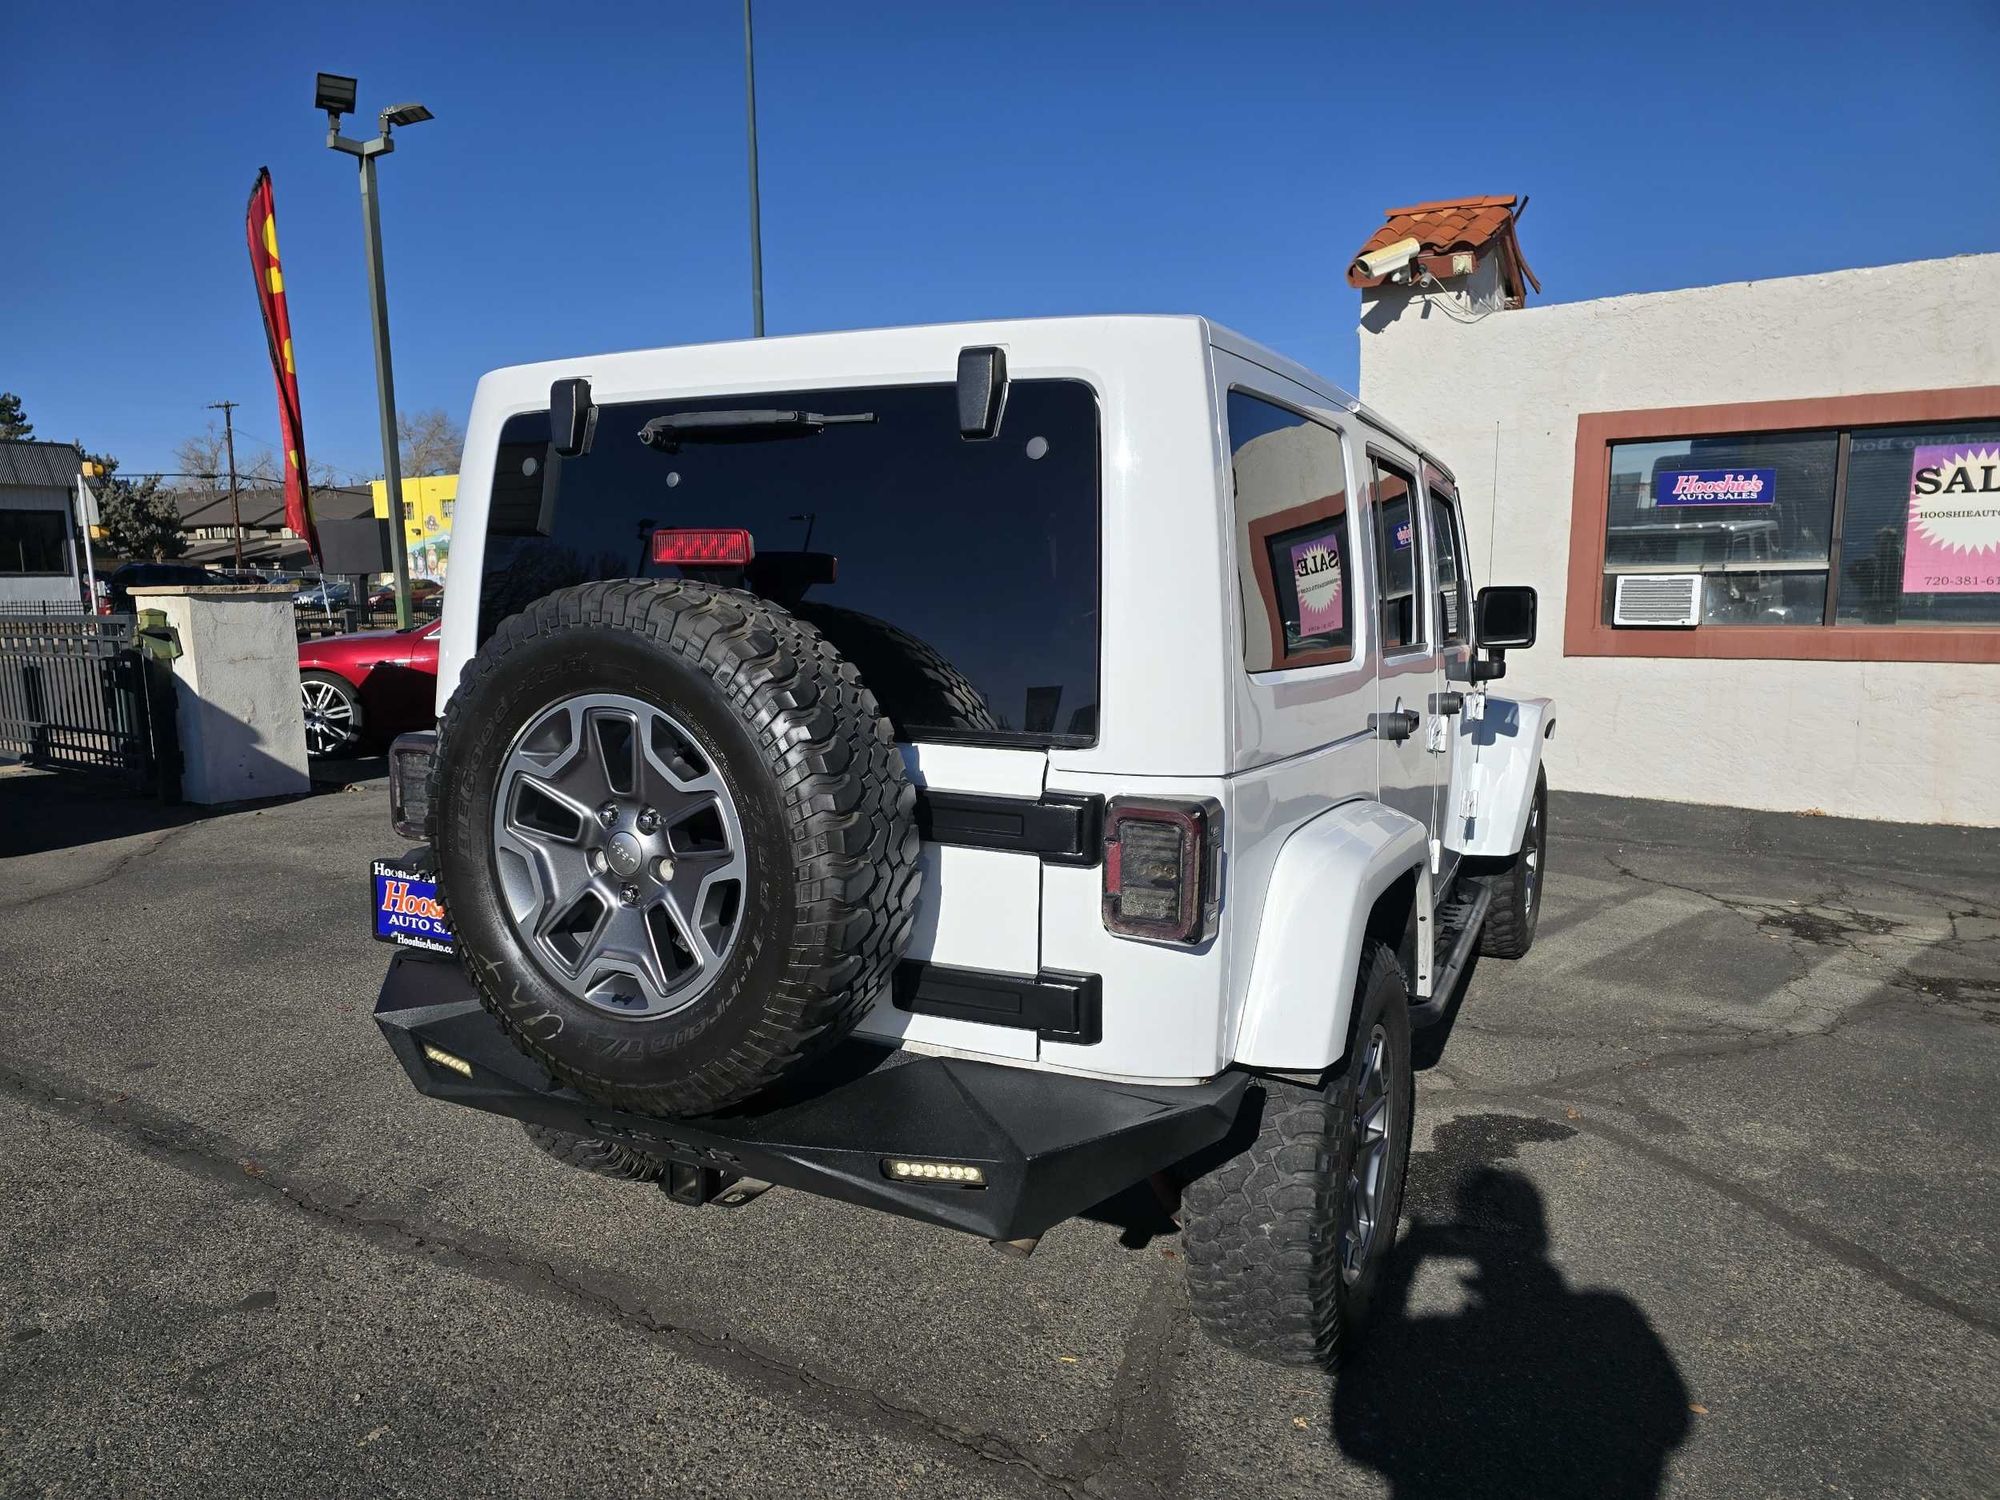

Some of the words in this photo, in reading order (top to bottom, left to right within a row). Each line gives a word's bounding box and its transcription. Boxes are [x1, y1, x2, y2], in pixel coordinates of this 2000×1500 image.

[1672, 474, 1763, 494] Hooshie's
[1718, 492, 1757, 500] SALES
[388, 914, 430, 931] AUTO
